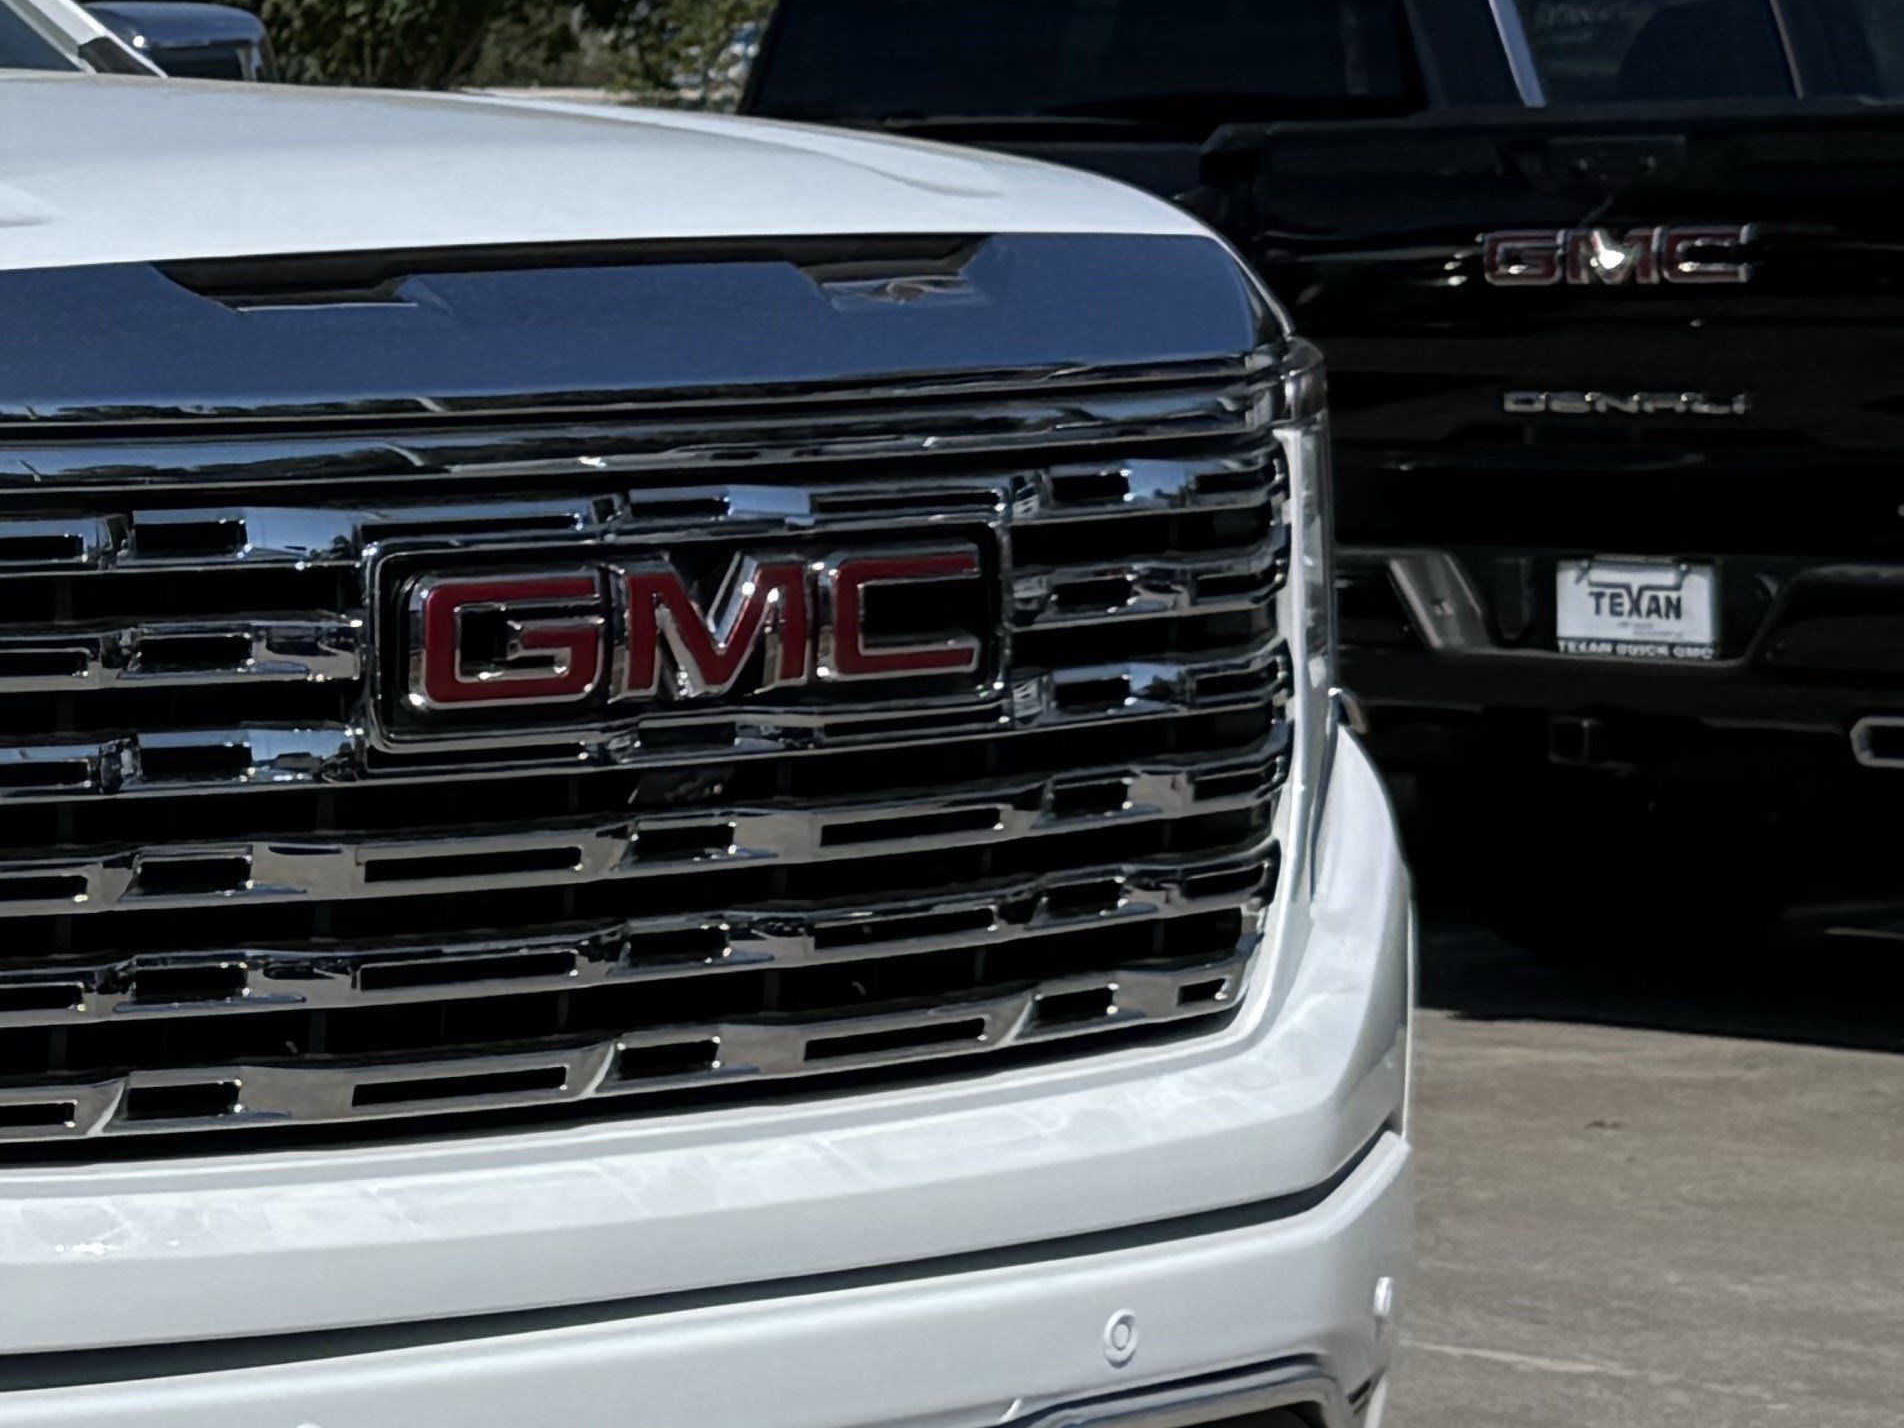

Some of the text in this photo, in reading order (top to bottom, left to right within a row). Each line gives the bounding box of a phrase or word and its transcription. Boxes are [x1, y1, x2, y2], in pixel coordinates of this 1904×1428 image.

[1479, 225, 1752, 286] GMC
[408, 544, 983, 711] GMC
[1588, 584, 1683, 620] TEXAN
